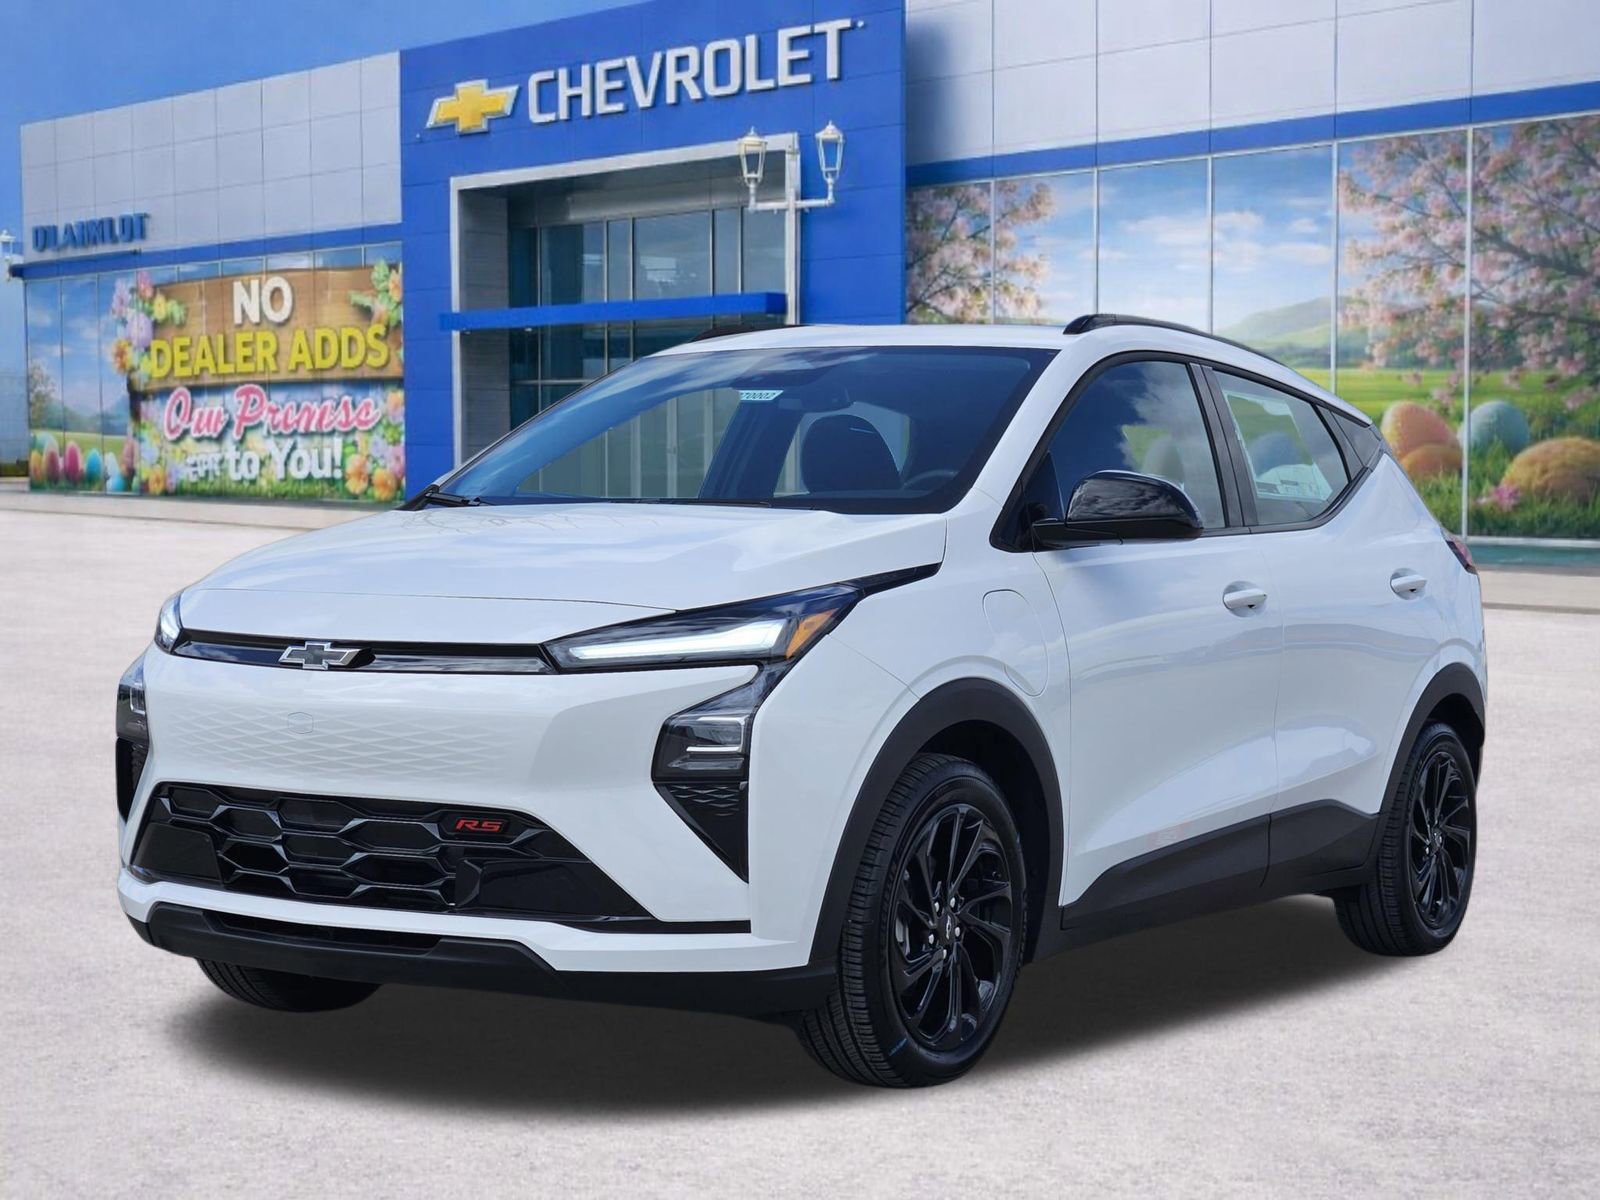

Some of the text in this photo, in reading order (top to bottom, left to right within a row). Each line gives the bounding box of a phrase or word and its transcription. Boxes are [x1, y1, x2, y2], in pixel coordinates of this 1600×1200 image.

[528, 18, 852, 124] CHEVROLET
[233, 276, 292, 324] NO
[150, 324, 389, 378] DEALER ADDS
[228, 444, 259, 481] to
[268, 437, 342, 479] You!
[455, 818, 503, 832] RS
